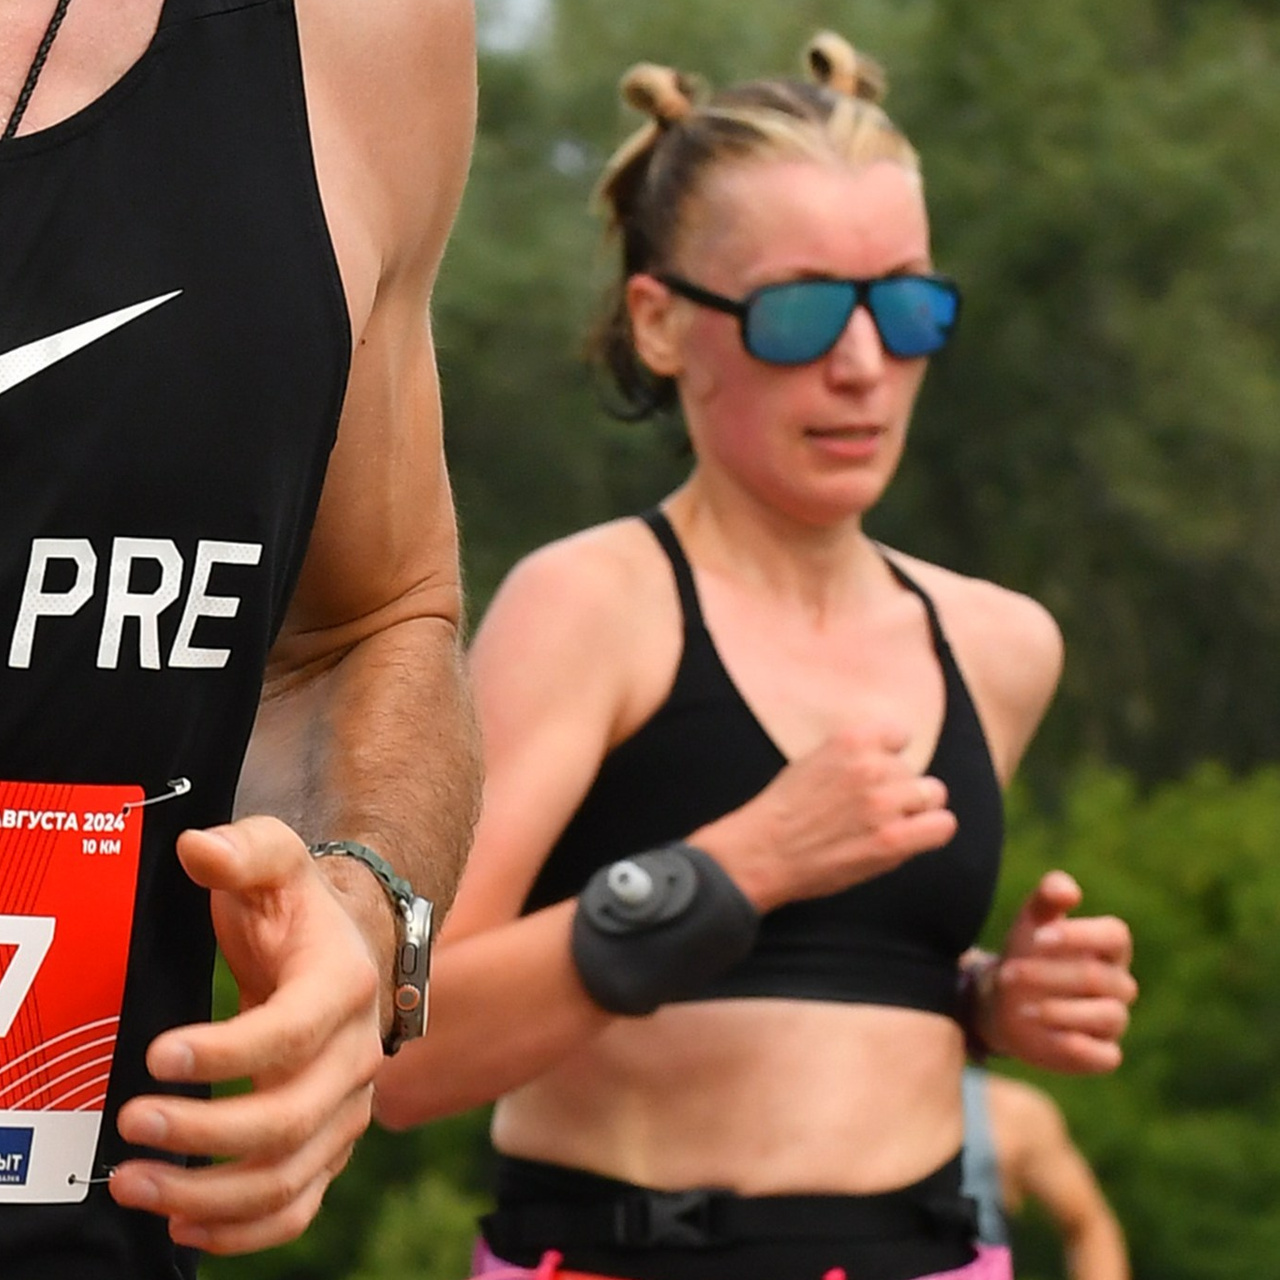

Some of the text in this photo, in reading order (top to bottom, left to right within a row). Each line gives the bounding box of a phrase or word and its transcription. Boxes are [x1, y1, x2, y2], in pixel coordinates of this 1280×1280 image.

[8, 536, 263, 670] PRE
[82, 812, 125, 832] 2024
[82, 838, 121, 855] 10 КМ
